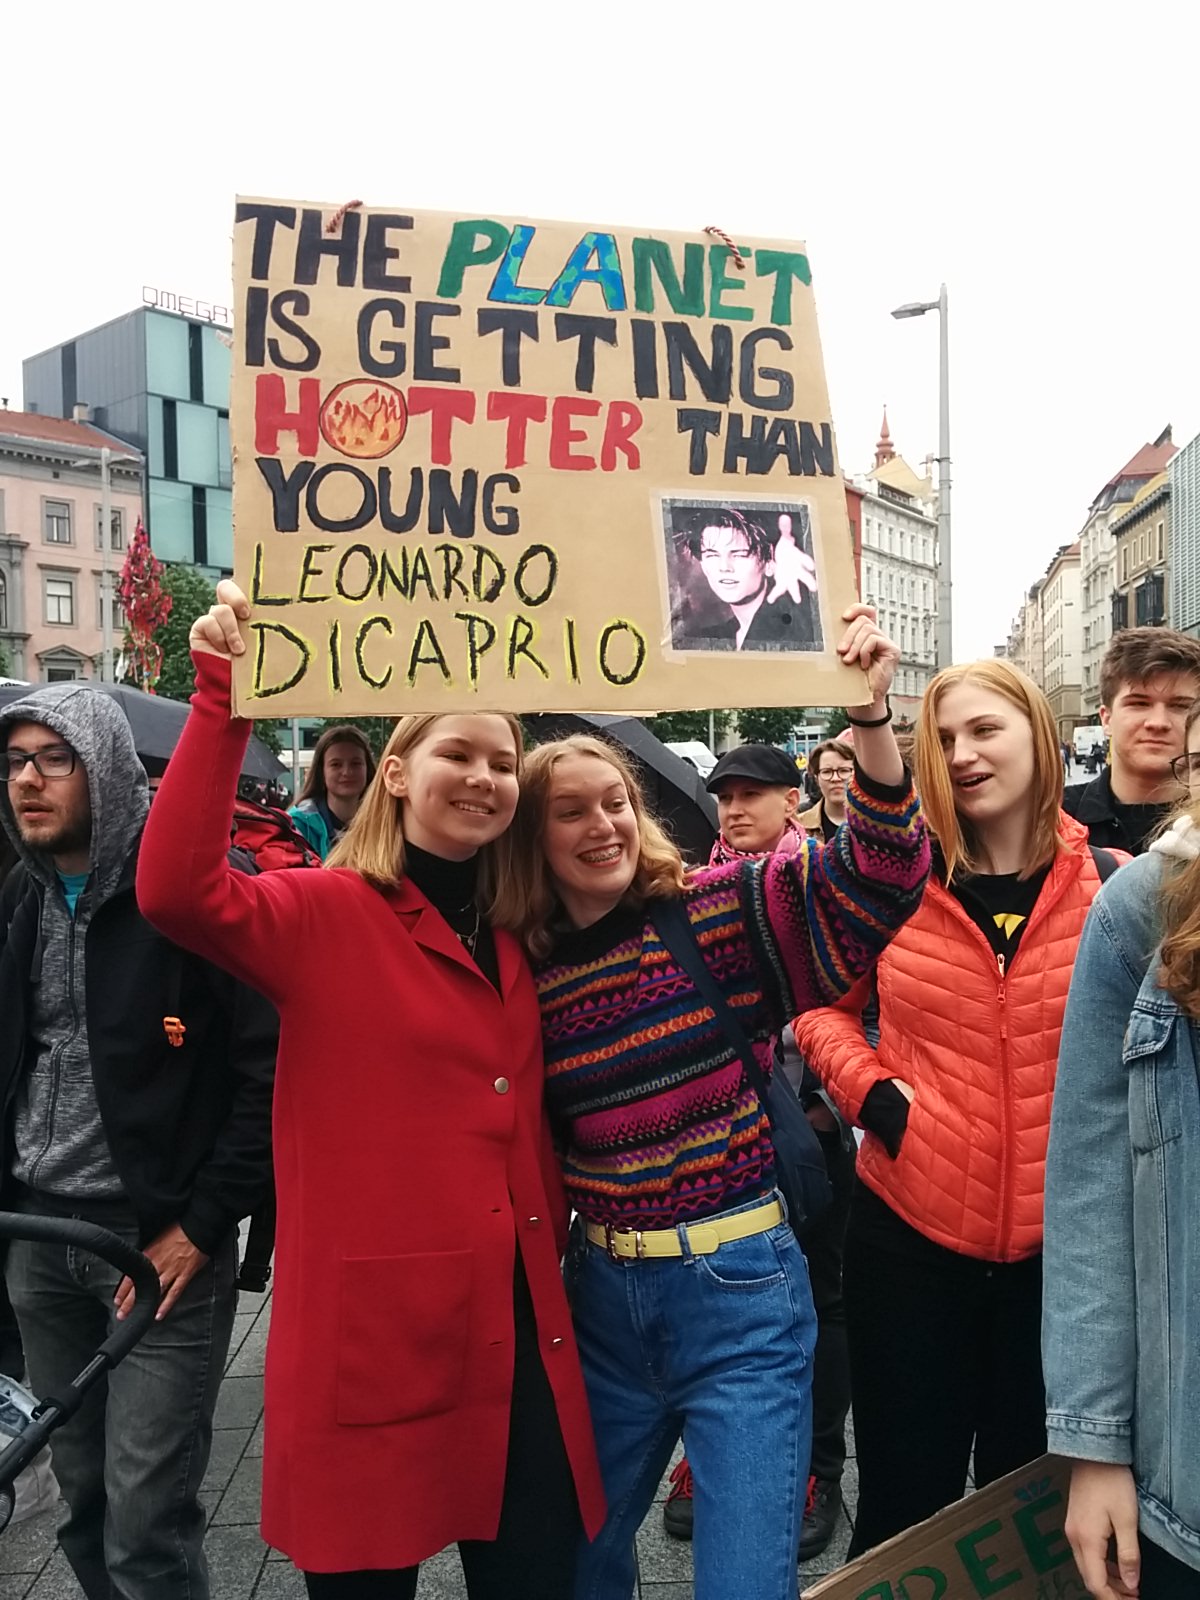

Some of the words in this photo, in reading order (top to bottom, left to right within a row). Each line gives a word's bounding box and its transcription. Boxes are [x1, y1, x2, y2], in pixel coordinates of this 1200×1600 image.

[142, 286, 227, 323] OMEGA
[235, 203, 414, 293] THE
[436, 219, 812, 326] PLANET
[245, 286, 321, 372] IS
[357, 298, 794, 411] GETTING
[254, 373, 643, 472] HOTTER
[677, 407, 836, 477] THAN
[255, 457, 521, 538] YOUNG
[252, 542, 558, 607] LEONARDO
[247, 612, 645, 699] DICAPRIO
